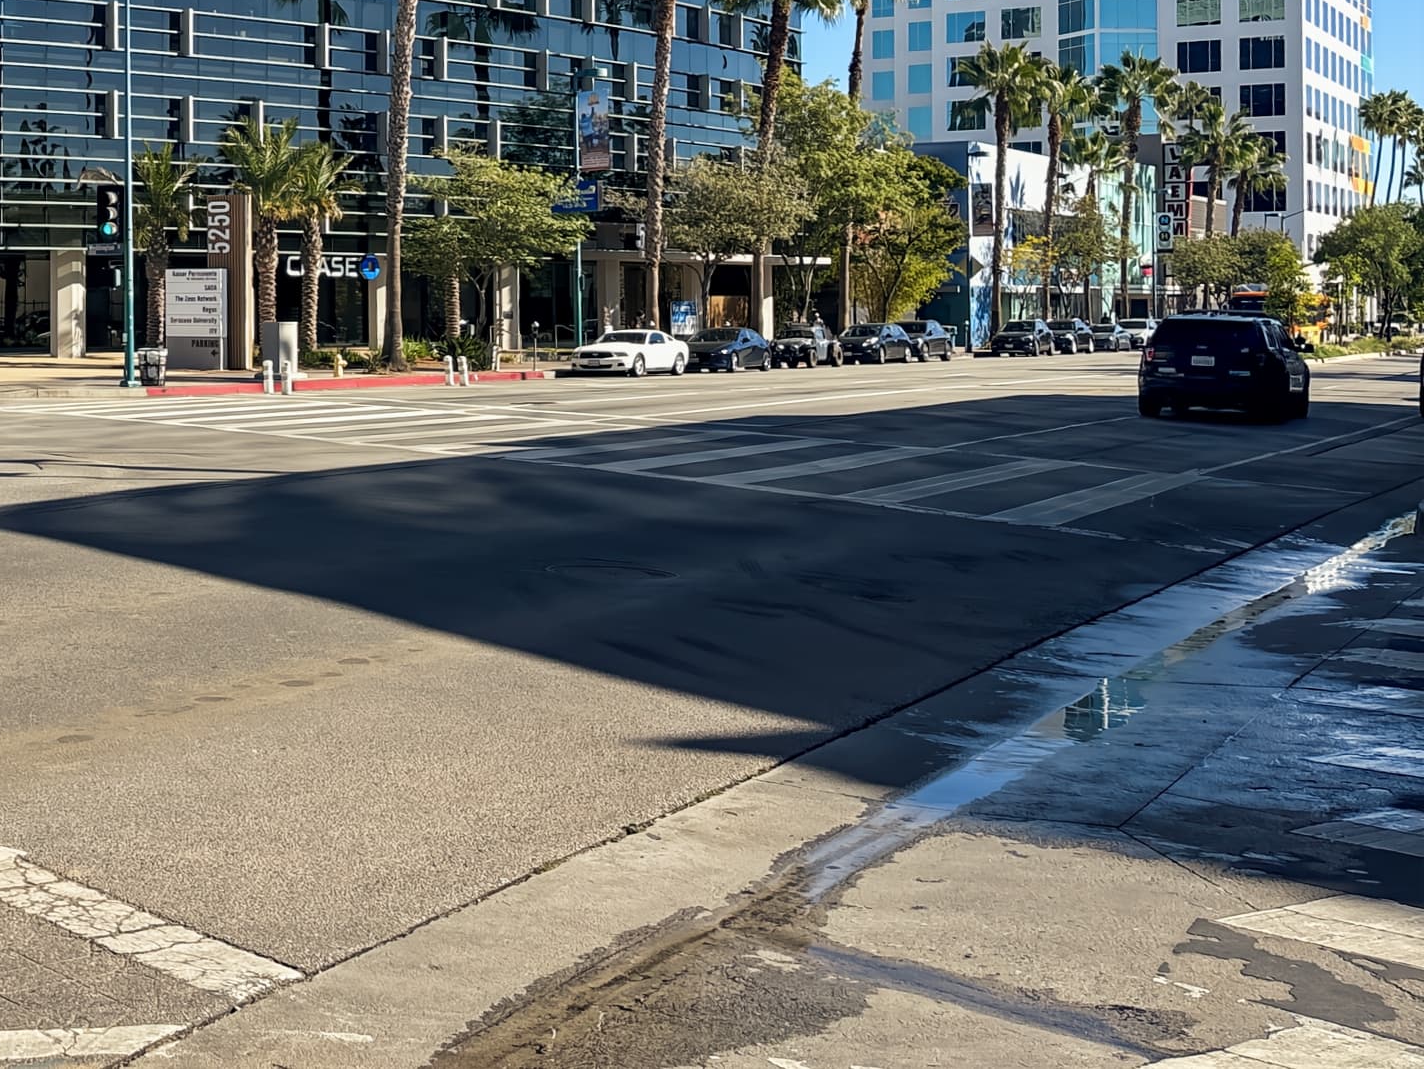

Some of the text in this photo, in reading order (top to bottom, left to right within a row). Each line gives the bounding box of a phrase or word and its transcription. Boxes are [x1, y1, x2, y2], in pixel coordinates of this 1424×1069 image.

[207, 200, 231, 254] 5250
[286, 255, 358, 277] CASE
[202, 306, 217, 314] Regus
[193, 317, 217, 325] University
[191, 339, 220, 348] PARKING
